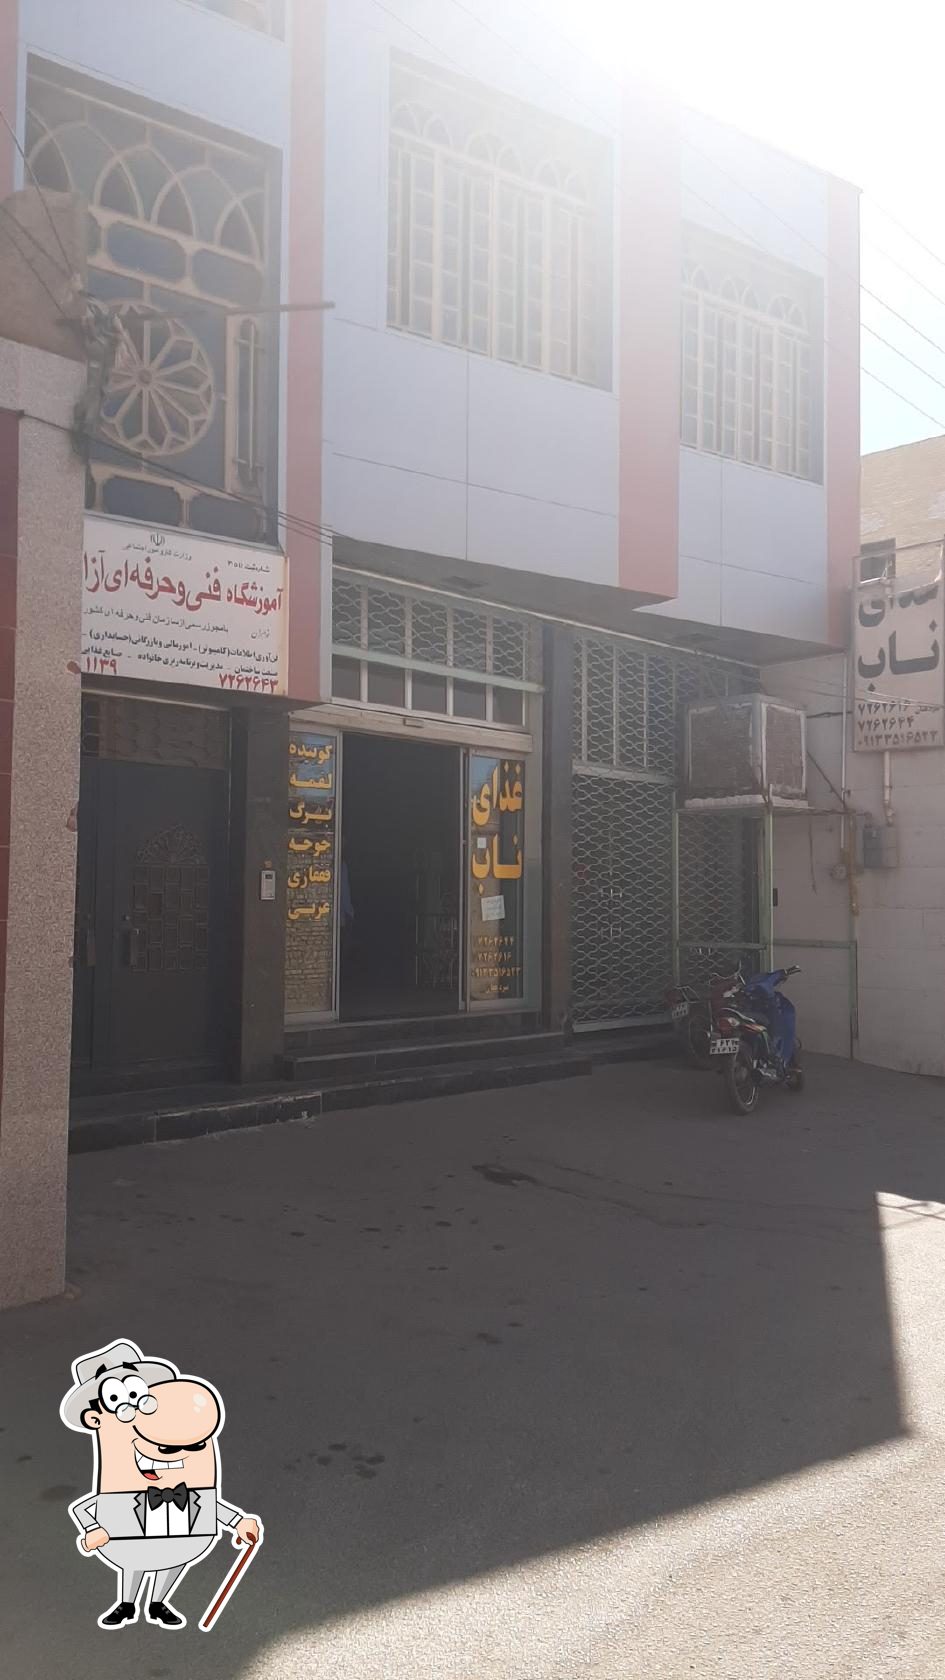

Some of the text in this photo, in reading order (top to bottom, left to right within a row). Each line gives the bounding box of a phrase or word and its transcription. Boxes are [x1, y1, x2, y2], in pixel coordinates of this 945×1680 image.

[83, 549, 106, 593] آزا
[104, 558, 129, 593] ای
[129, 556, 177, 601] حرفه
[185, 566, 222, 611] فنی
[226, 581, 284, 616] آموزشگاه
[139, 611, 152, 624] فنی
[152, 615, 180, 626] سازمان
[857, 620, 941, 693] ناب
[289, 743, 333, 765] کوبیده
[288, 769, 333, 790] لقمه
[472, 760, 523, 826] غذای
[288, 800, 333, 829] برگ
[288, 836, 331, 858] جوجه
[472, 833, 523, 895] ناب
